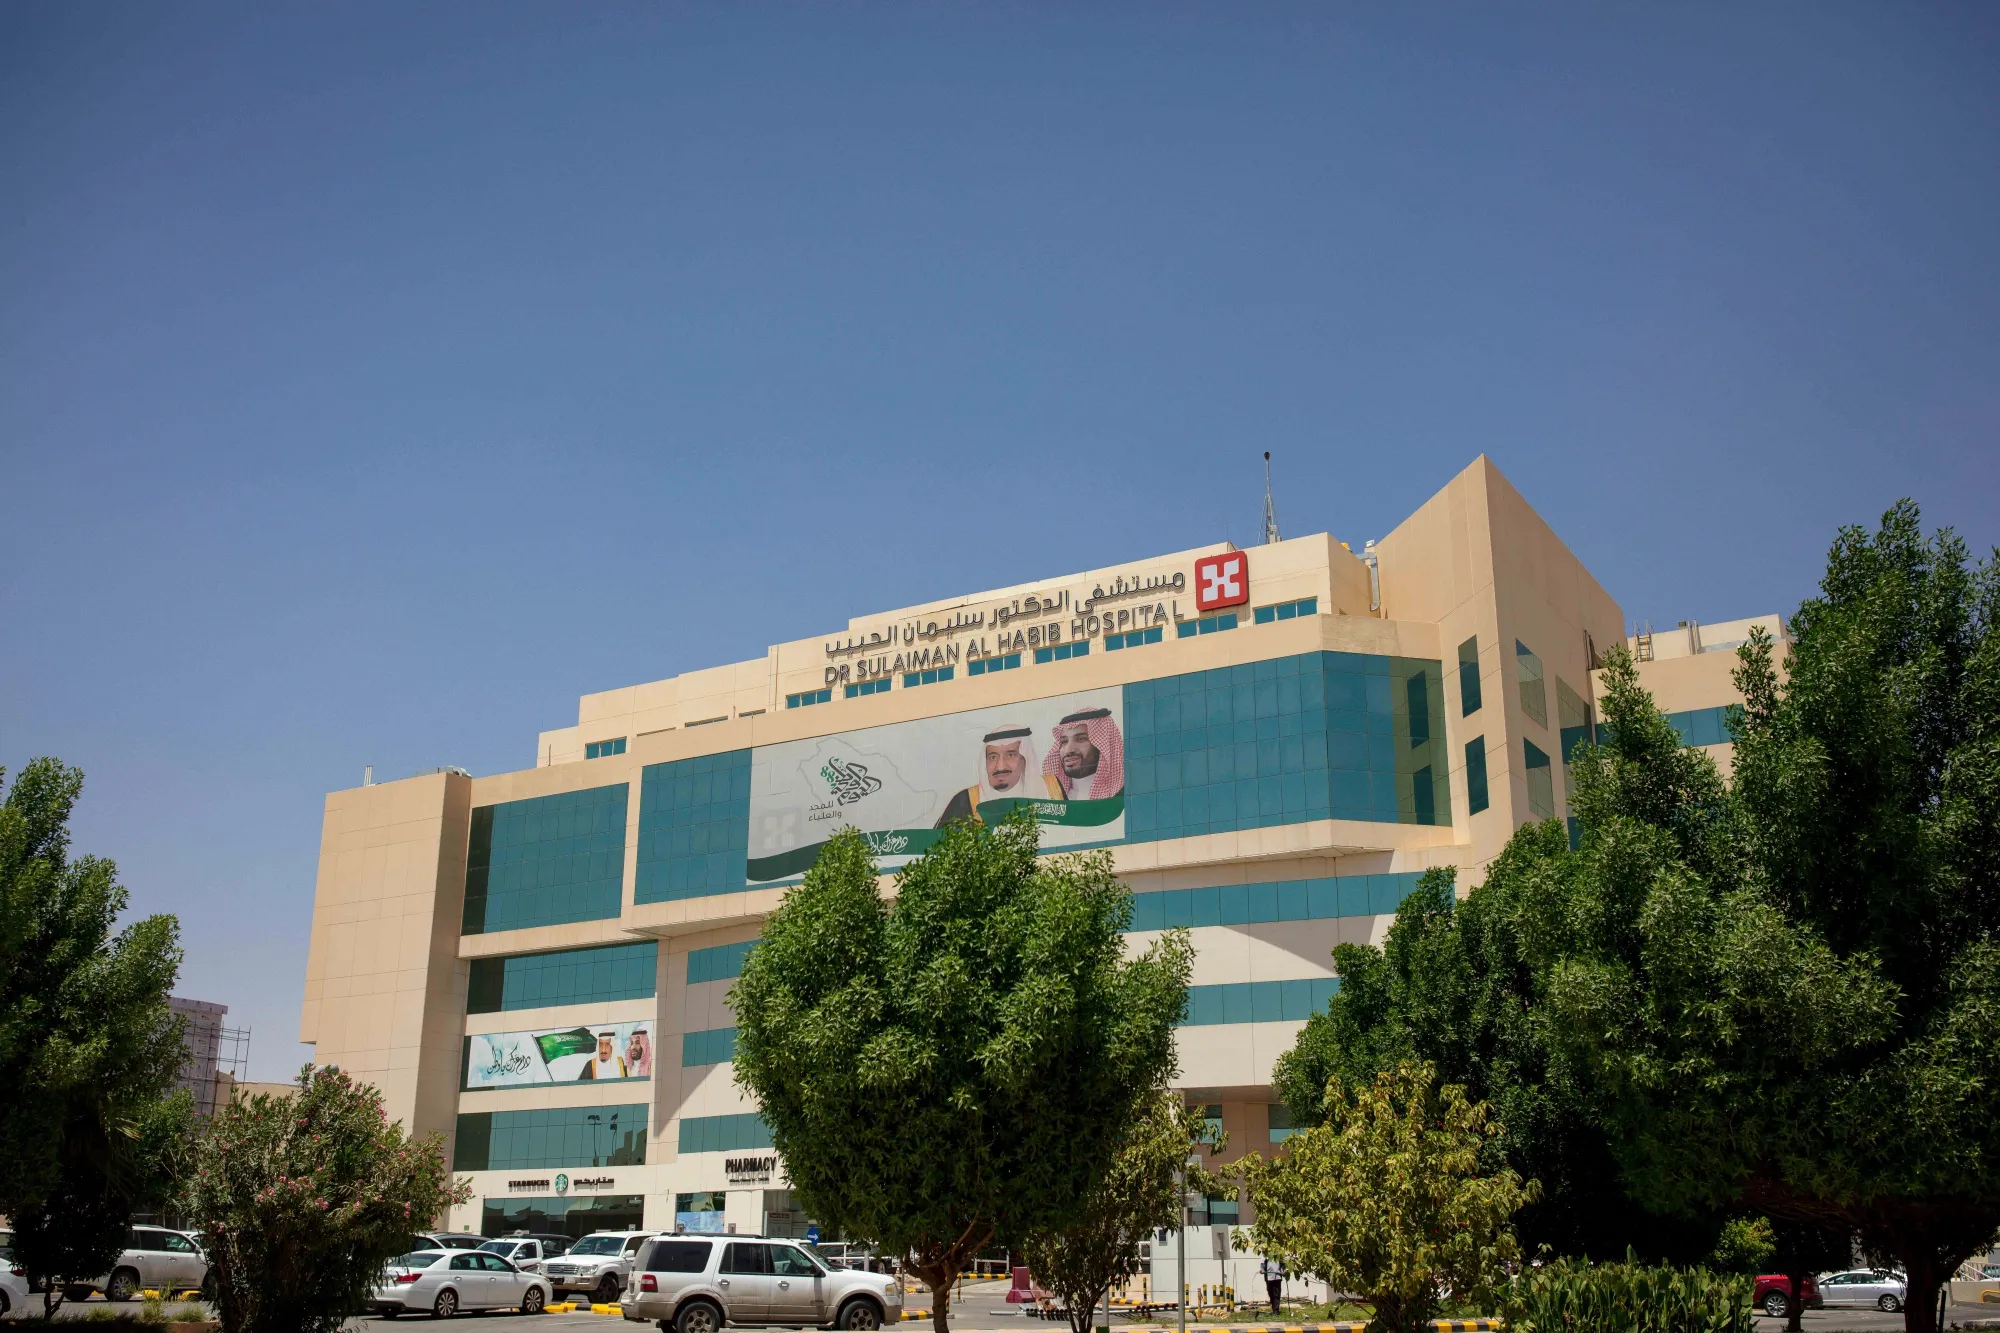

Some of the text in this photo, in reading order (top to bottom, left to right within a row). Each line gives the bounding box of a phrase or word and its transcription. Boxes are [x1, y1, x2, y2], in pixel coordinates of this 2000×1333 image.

[825, 572, 1186, 658] مستشفى الدكتور سليمان الحبيب
[825, 600, 1185, 684] DR SULAIMAN AL HABIB HOSPITAL
[820, 766, 836, 783] 88
[725, 1157, 776, 1173] PHARMACY
[508, 1179, 550, 1188] STARBUCKS
[573, 1176, 615, 1186] ستاربكس
